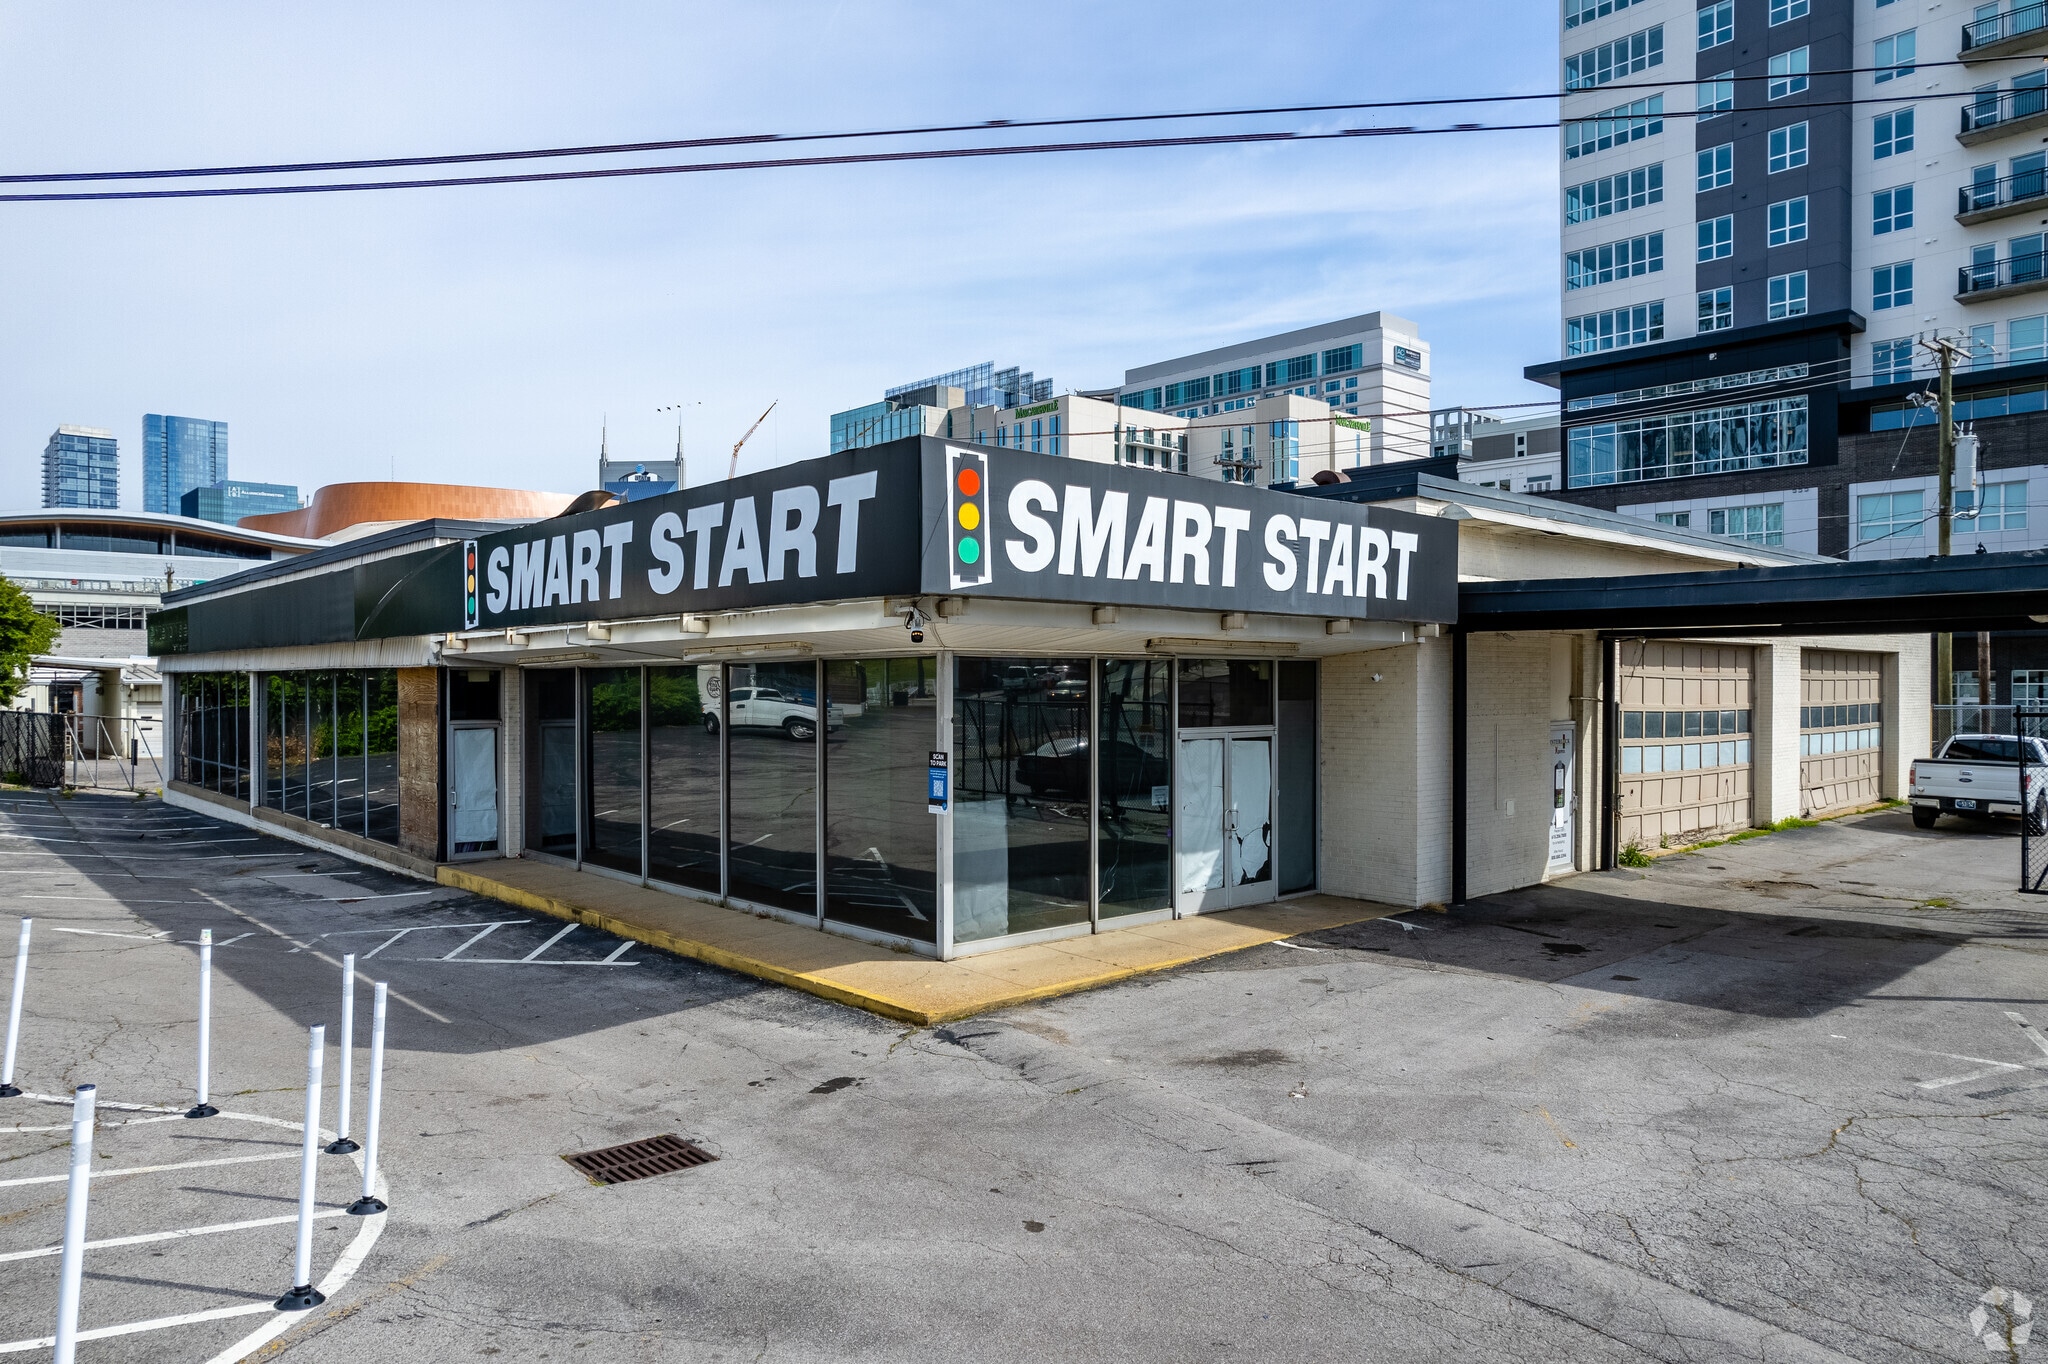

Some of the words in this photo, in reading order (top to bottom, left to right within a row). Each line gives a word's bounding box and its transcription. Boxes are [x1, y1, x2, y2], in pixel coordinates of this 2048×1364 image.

[486, 520, 634, 614] SMART
[647, 470, 878, 595] START
[1004, 479, 1251, 588] SMART
[1263, 514, 1419, 601] START
